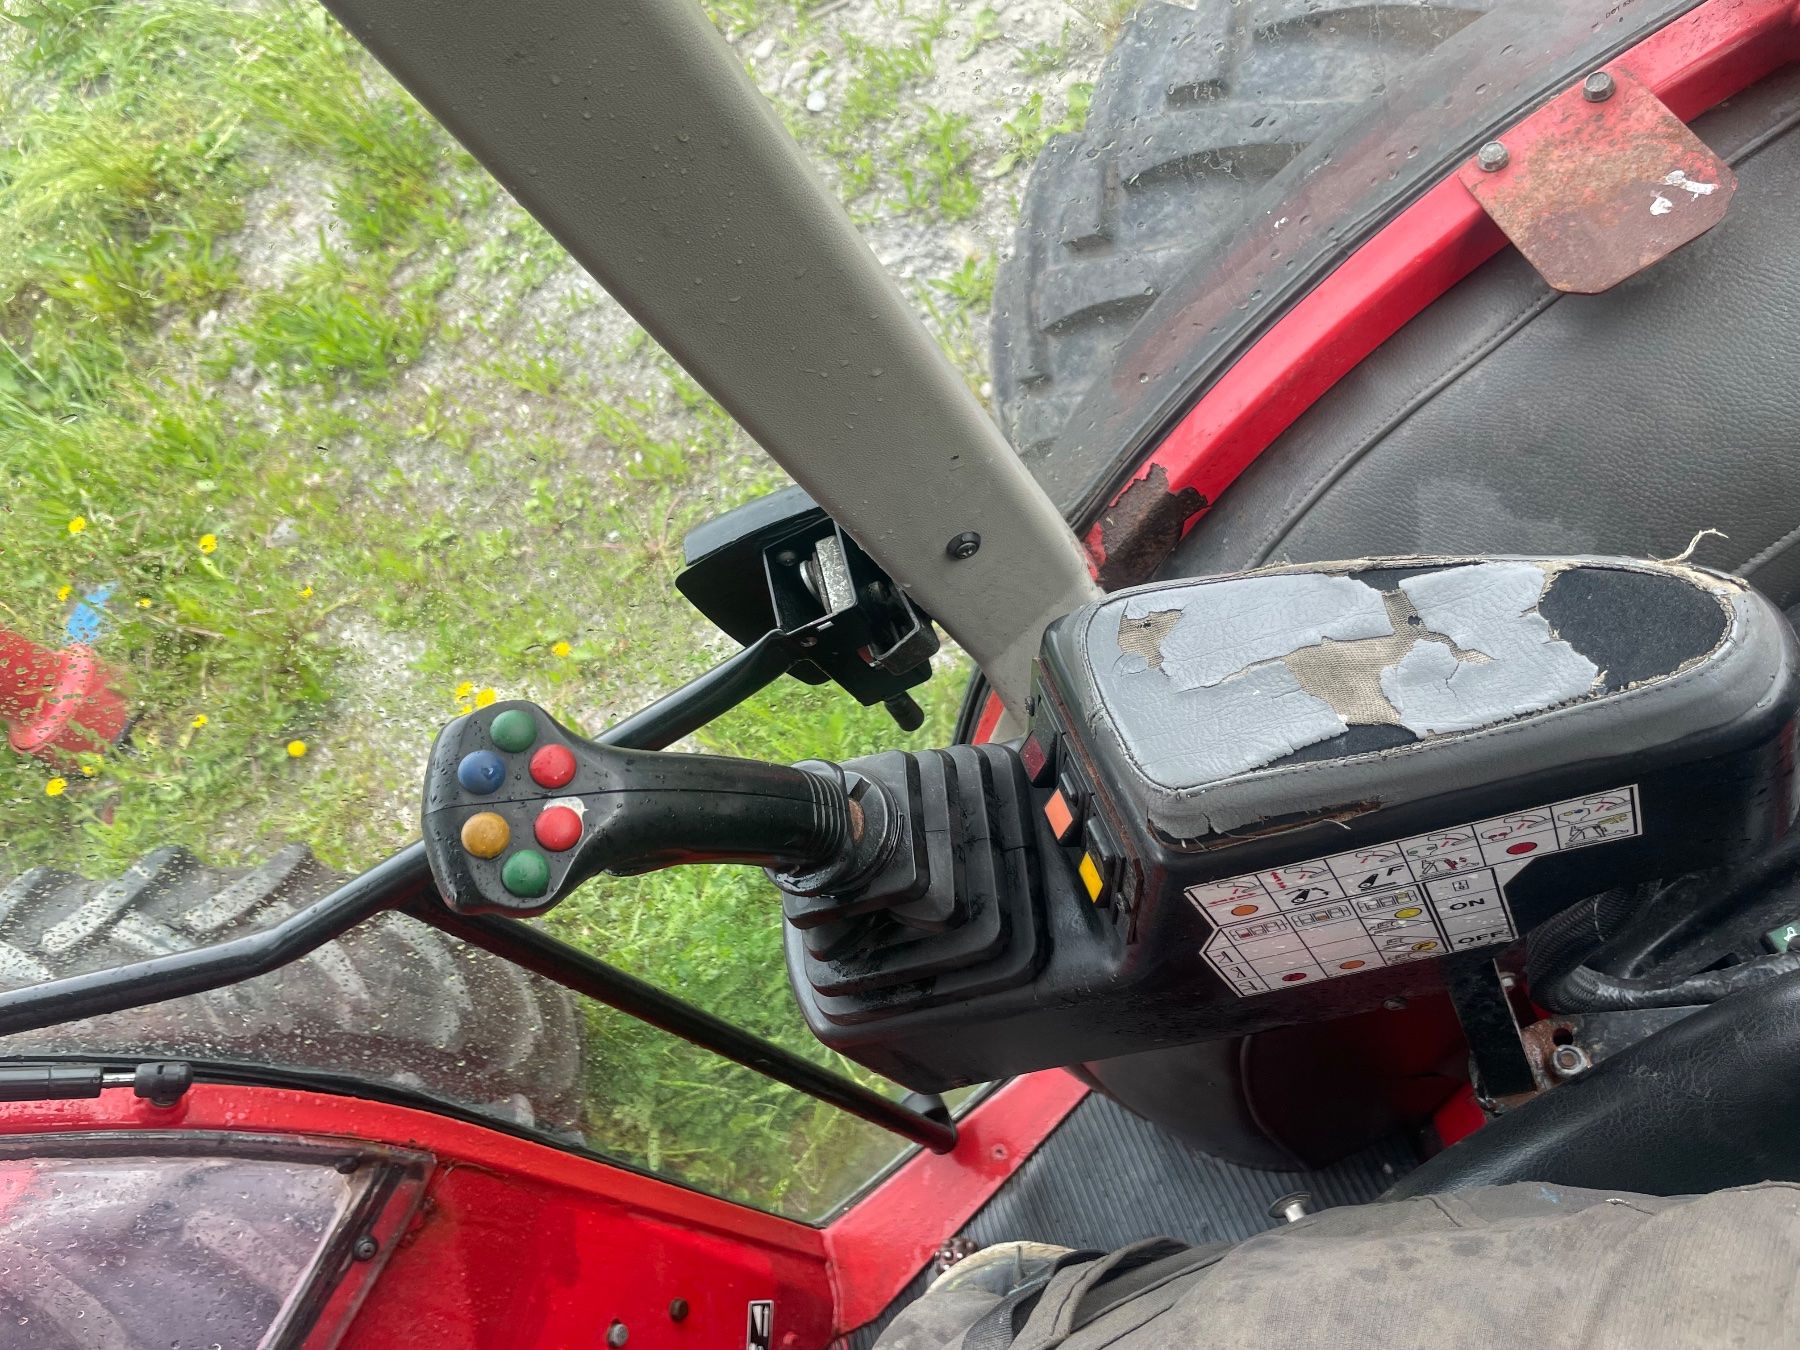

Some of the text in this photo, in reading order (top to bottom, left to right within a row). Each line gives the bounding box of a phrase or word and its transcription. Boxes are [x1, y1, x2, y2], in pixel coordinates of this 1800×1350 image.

[1387, 864, 1404, 876] F
[1450, 897, 1485, 911] ON
[1458, 929, 1504, 944] OFF
